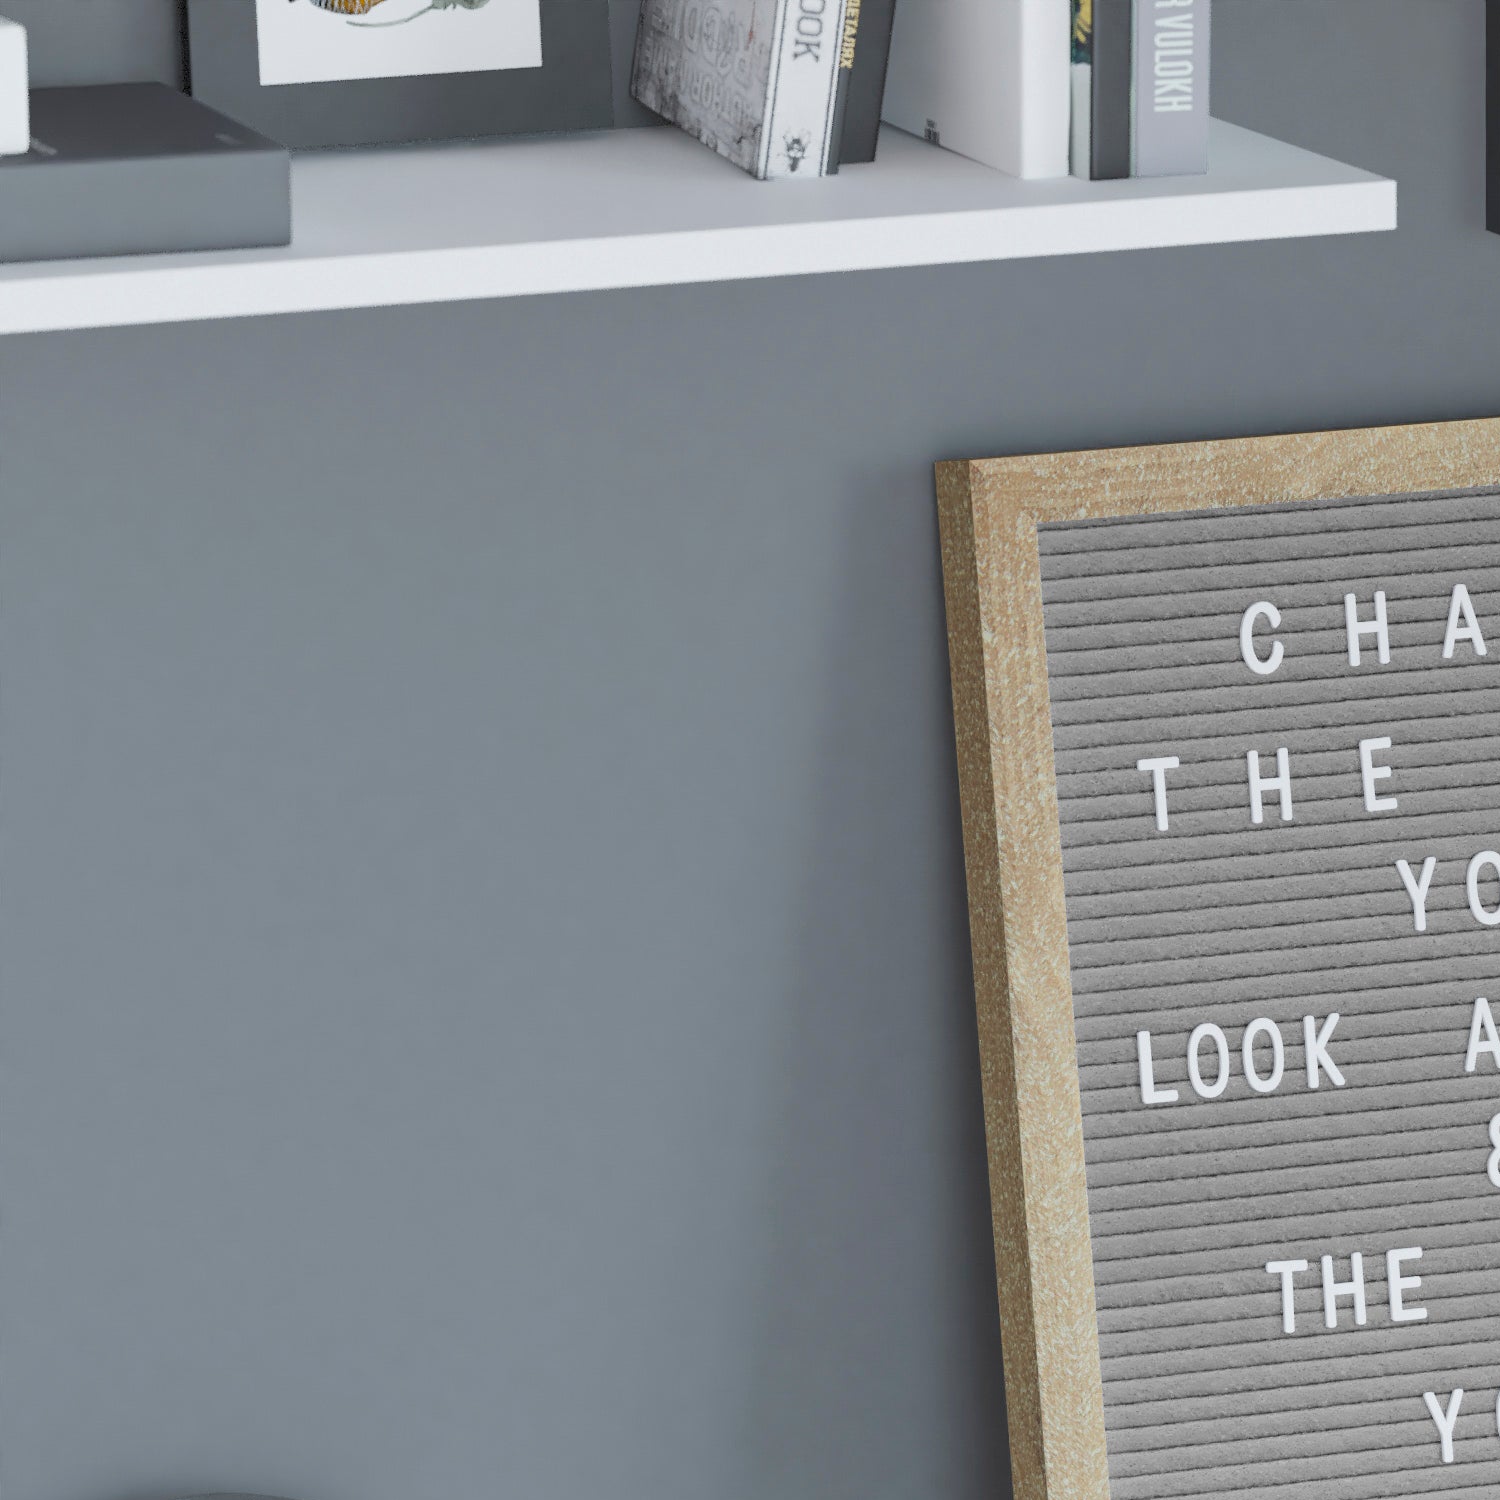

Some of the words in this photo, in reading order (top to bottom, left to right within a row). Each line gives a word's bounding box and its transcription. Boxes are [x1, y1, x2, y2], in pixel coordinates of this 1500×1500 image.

[1154, 13, 1194, 112] VULOKH
[1136, 735, 1400, 833] THE
[1136, 1011, 1348, 1106] LOOK
[1264, 1245, 1430, 1336] THE
